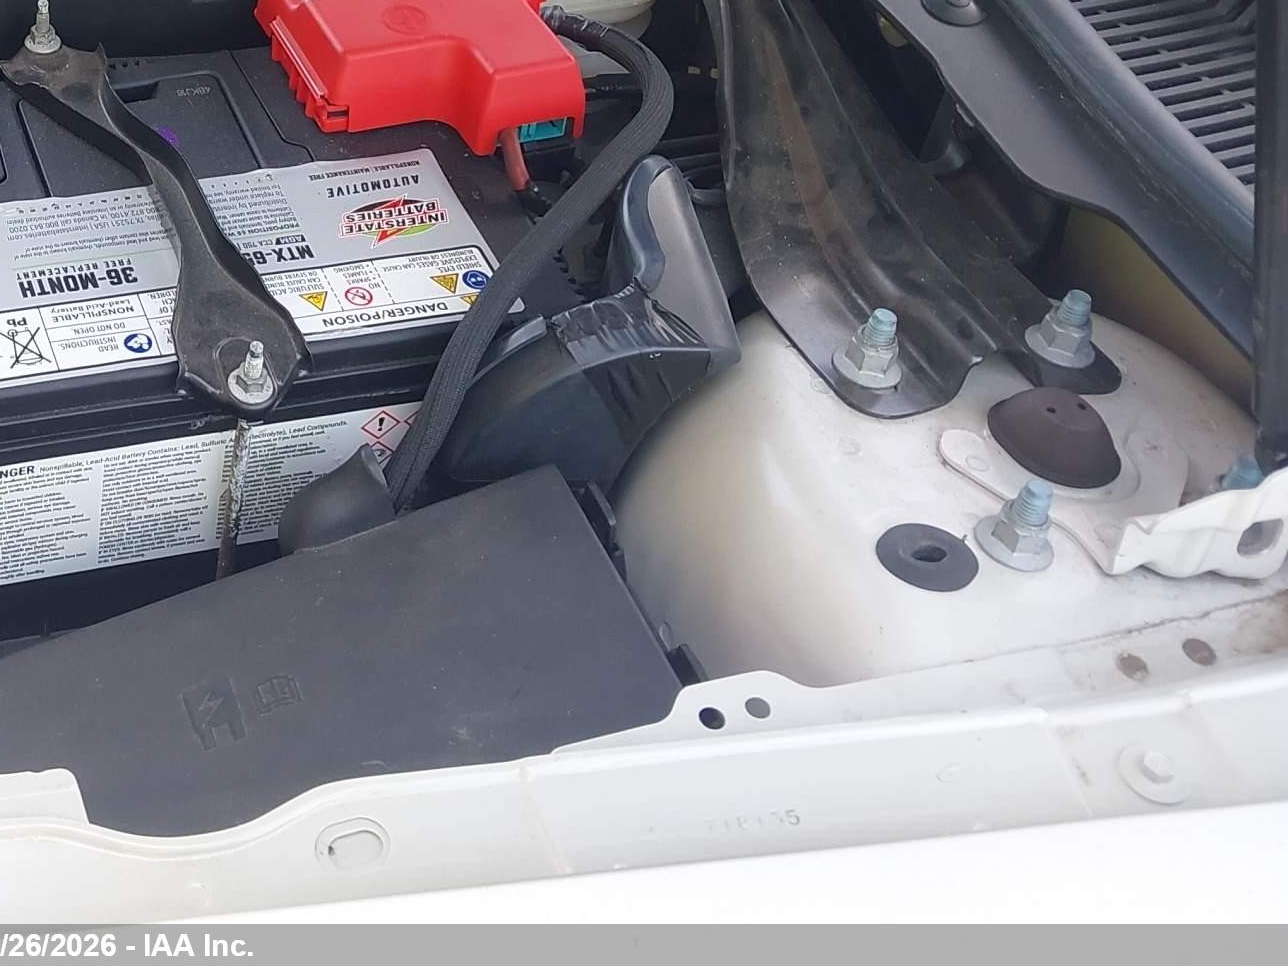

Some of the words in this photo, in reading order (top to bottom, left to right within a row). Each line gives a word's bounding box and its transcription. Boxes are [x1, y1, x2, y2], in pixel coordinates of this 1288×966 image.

[323, 174, 423, 198] AUTOMOTIVE
[343, 201, 439, 223] BATTERIES
[340, 211, 447, 235] INTERSTATE
[102, 257, 132, 268] FREE
[414, 259, 440, 269] GASES
[437, 253, 478, 266] EXPLOSIVE
[454, 260, 482, 271] SHIELD
[14, 261, 99, 281] REPLACEMENT
[331, 263, 365, 273] SMOKING
[16, 265, 139, 299] 36-MONTH
[286, 281, 325, 294] SULFURIC
[366, 281, 381, 289] NO
[49, 303, 84, 315] Battery
[83, 297, 130, 310] Lead-Acid
[50, 304, 135, 324] NONSPILLABLE
[320, 300, 449, 328] DANGER/POISON
[4, 316, 28, 328] Pb
[95, 322, 112, 331] NOT
[112, 321, 126, 329] DO
[96, 343, 119, 352] READ
[39, 459, 84, 473] Nonspillable,
[85, 454, 119, 465] Lead-Acid
[120, 450, 145, 460] Battery
[288, 425, 306, 434] Lead
[306, 418, 348, 432] Compounds.
